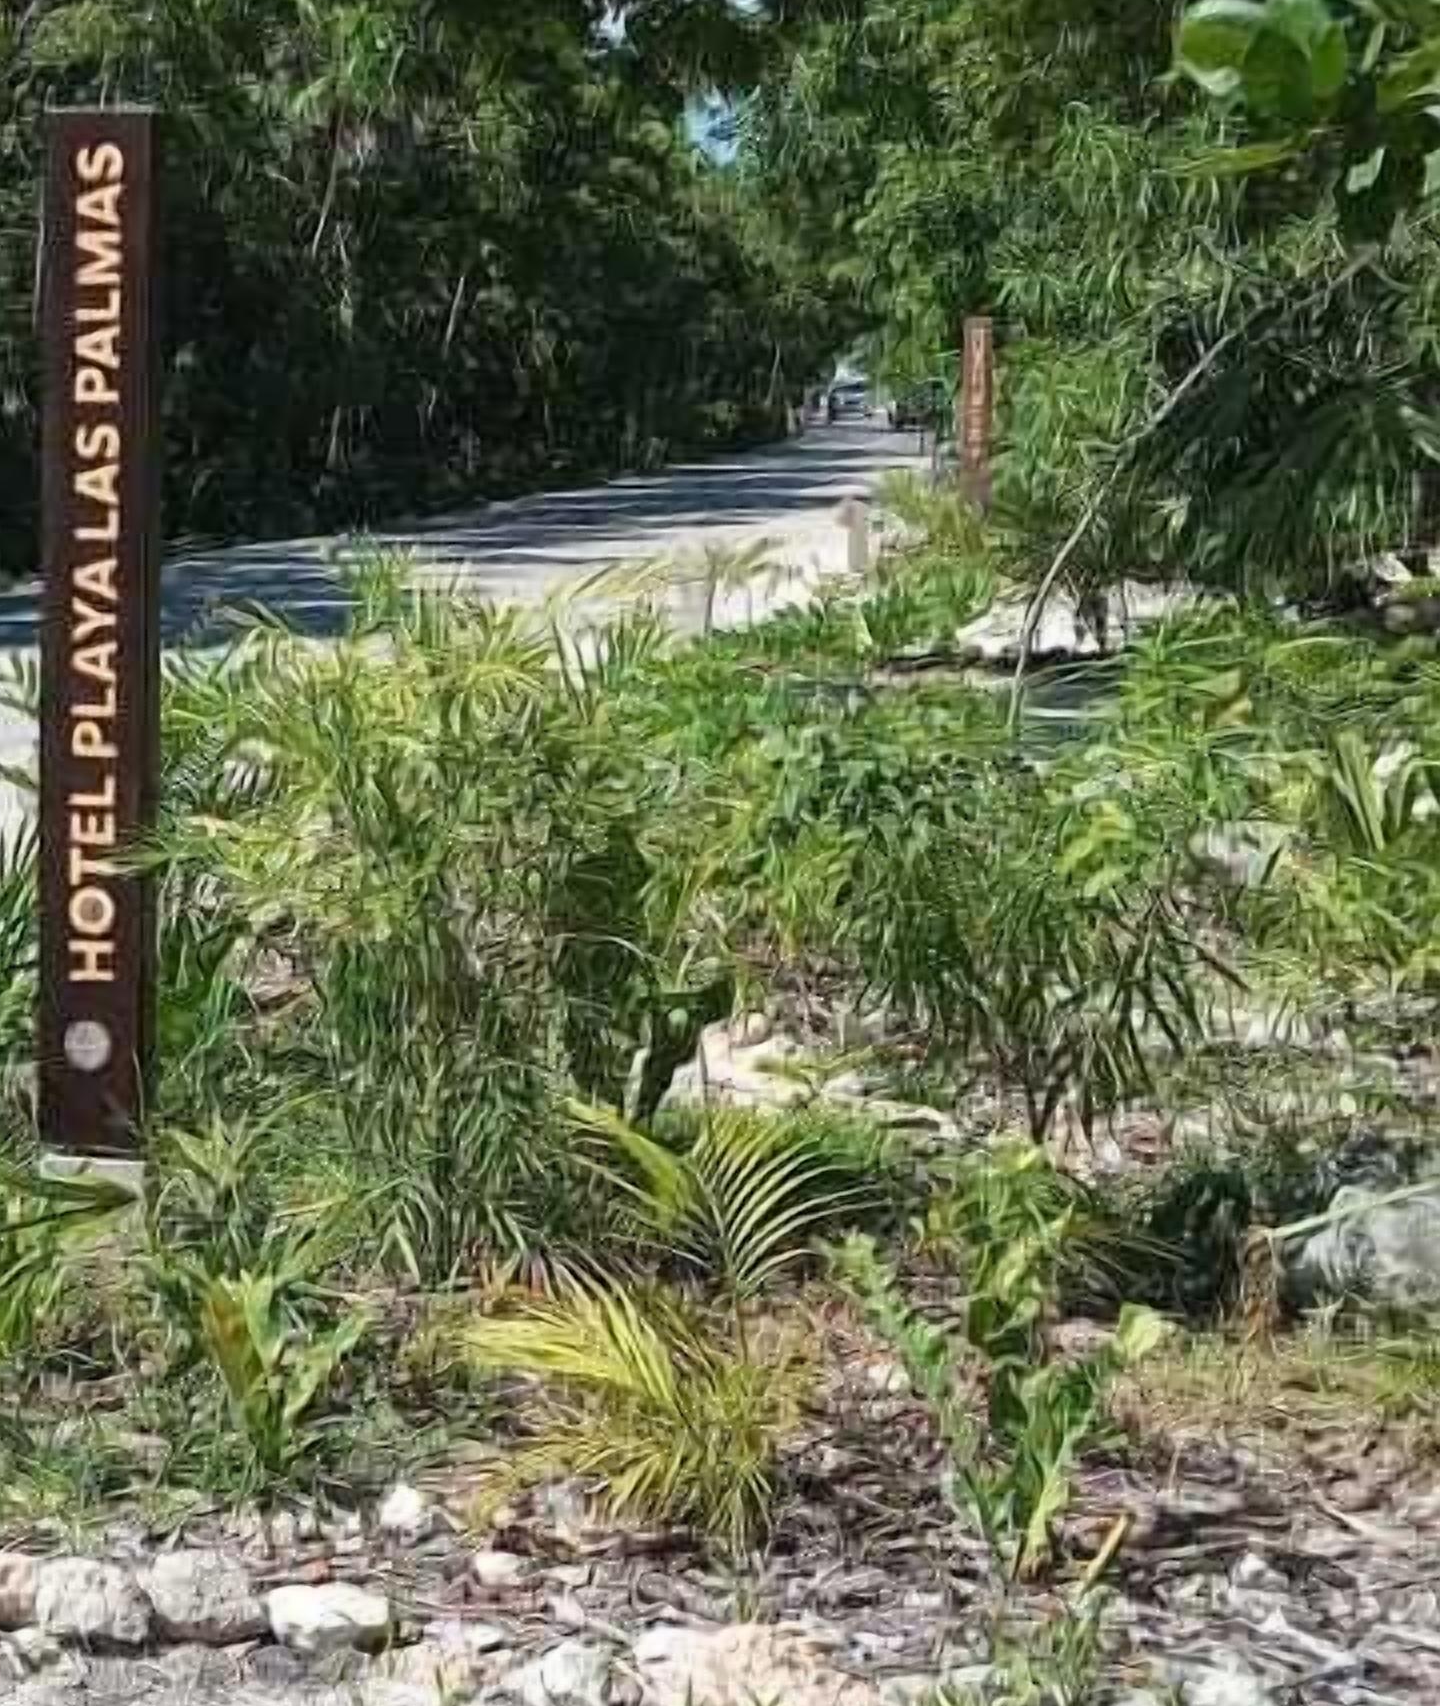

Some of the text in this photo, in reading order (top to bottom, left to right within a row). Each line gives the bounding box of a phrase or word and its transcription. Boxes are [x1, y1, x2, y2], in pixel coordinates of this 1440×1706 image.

[68, 142, 123, 982] HOTEL PLAYA LAS PALMAS
